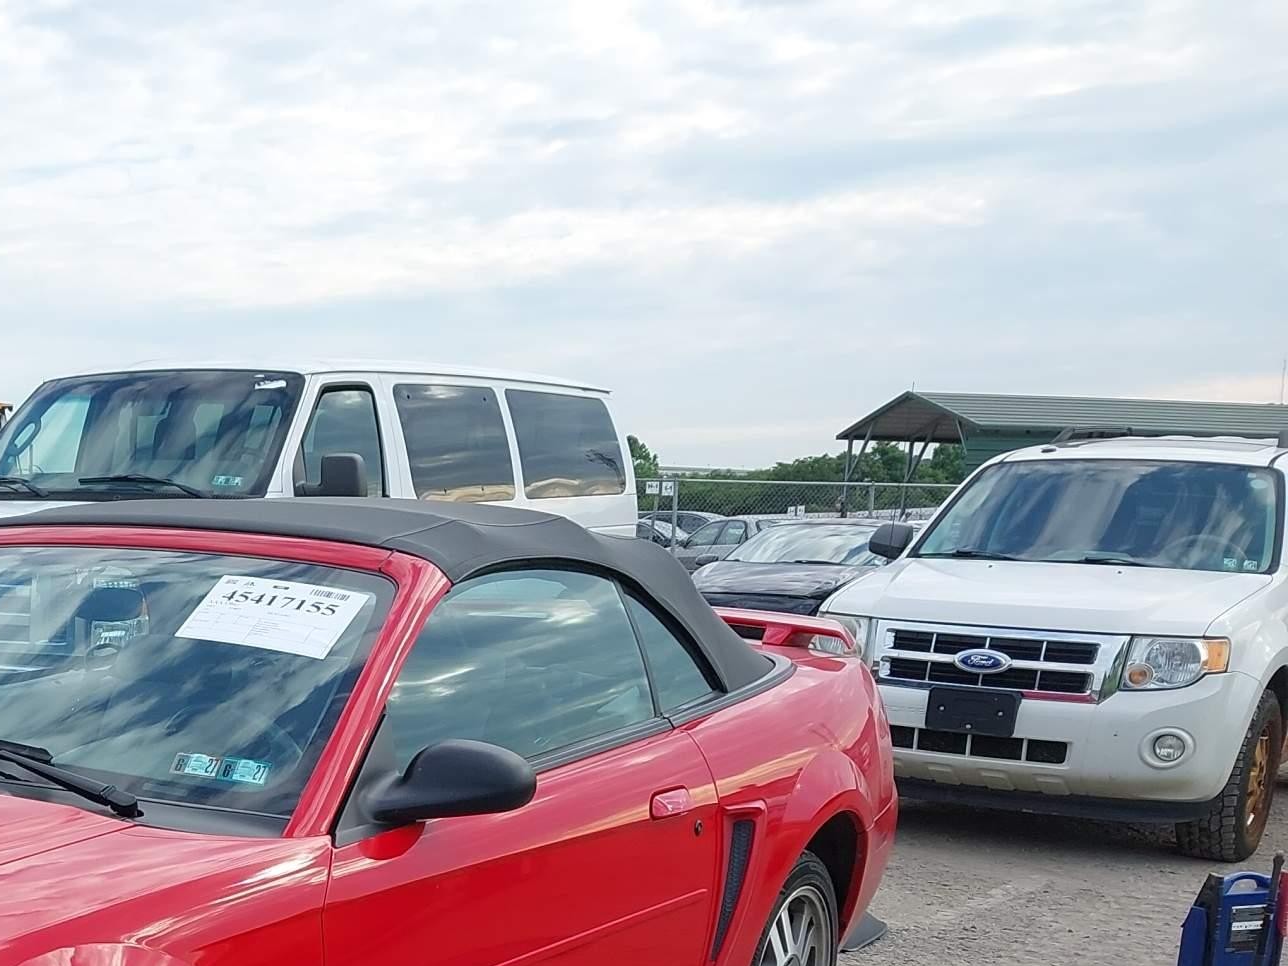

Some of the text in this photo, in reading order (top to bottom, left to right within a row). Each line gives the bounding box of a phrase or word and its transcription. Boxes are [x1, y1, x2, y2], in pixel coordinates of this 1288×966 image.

[222, 589, 340, 616] 45417155
[967, 654, 995, 667] Ford
[174, 758, 220, 775] 6 27
[222, 763, 267, 782] 6 27
